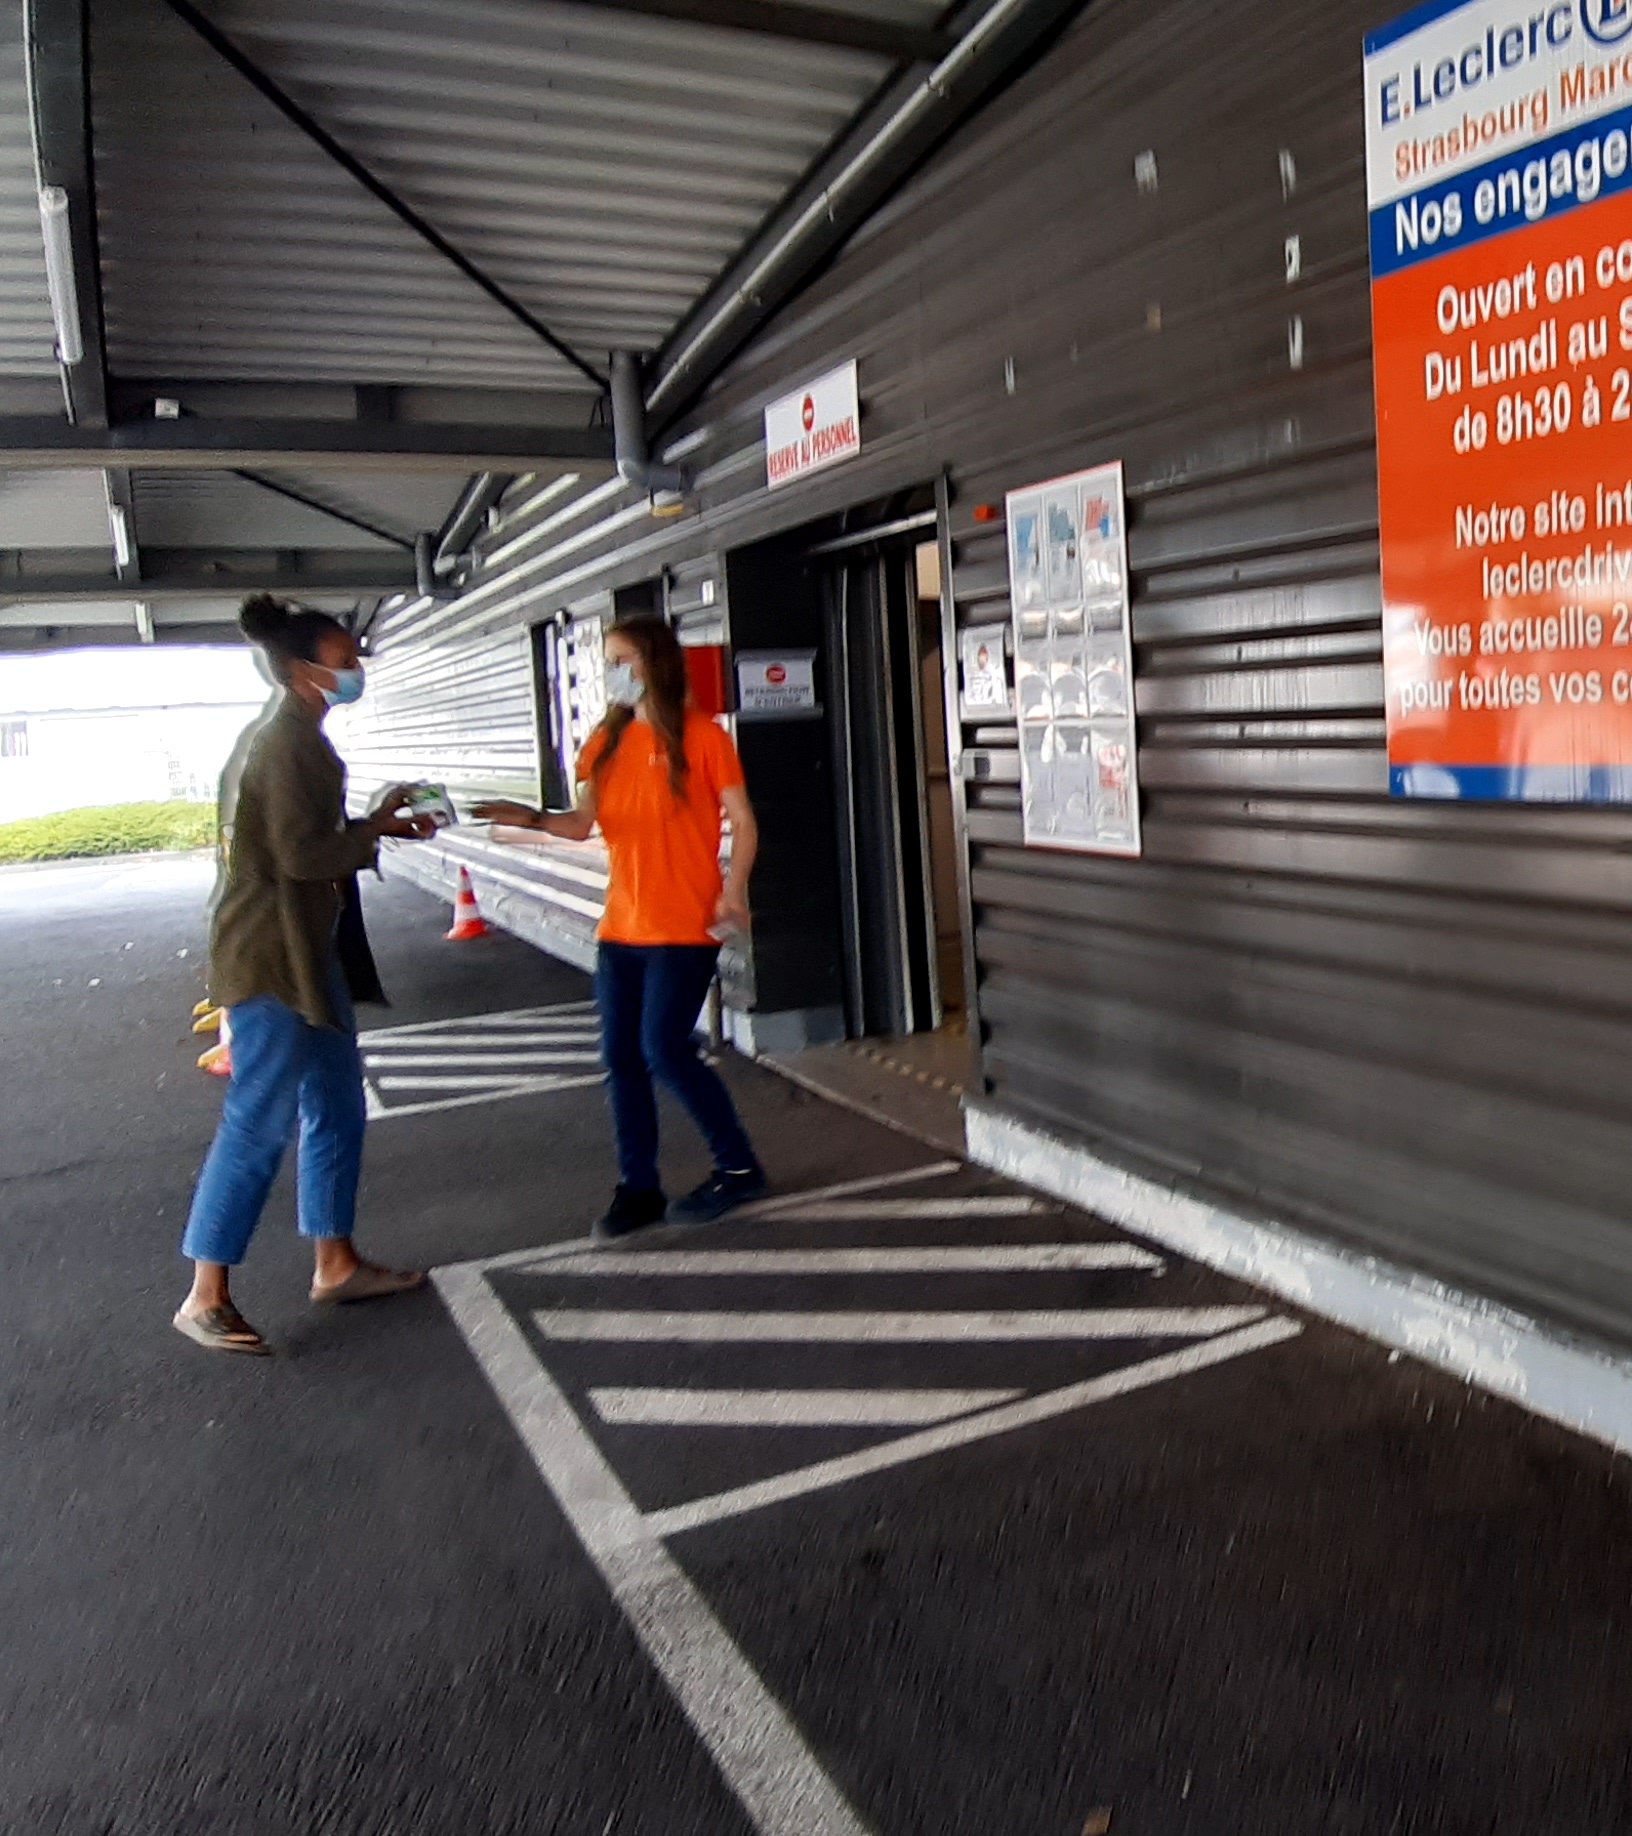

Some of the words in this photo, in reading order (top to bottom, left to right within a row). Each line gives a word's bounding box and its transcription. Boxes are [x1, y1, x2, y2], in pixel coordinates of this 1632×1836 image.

[1379, 3, 1574, 129] E.Leclerc
[1394, 86, 1550, 180] Strasbourg
[1396, 192, 1463, 255] Nos
[1437, 260, 1537, 335] Ouvert
[1545, 253, 1585, 304] en
[1425, 350, 1462, 401] Du
[1470, 317, 1558, 391] Lundi
[1568, 314, 1608, 369] au
[1453, 404, 1487, 455] de
[1495, 380, 1572, 446] 8h30
[1582, 376, 1600, 428] à
[1455, 500, 1526, 550] Notre
[1534, 490, 1586, 535] site
[1414, 617, 1473, 657] Vous
[1479, 604, 1603, 656] accueille
[1400, 671, 1453, 717] pour
[1458, 668, 1541, 711] toutes
[1549, 667, 1602, 704] vos
